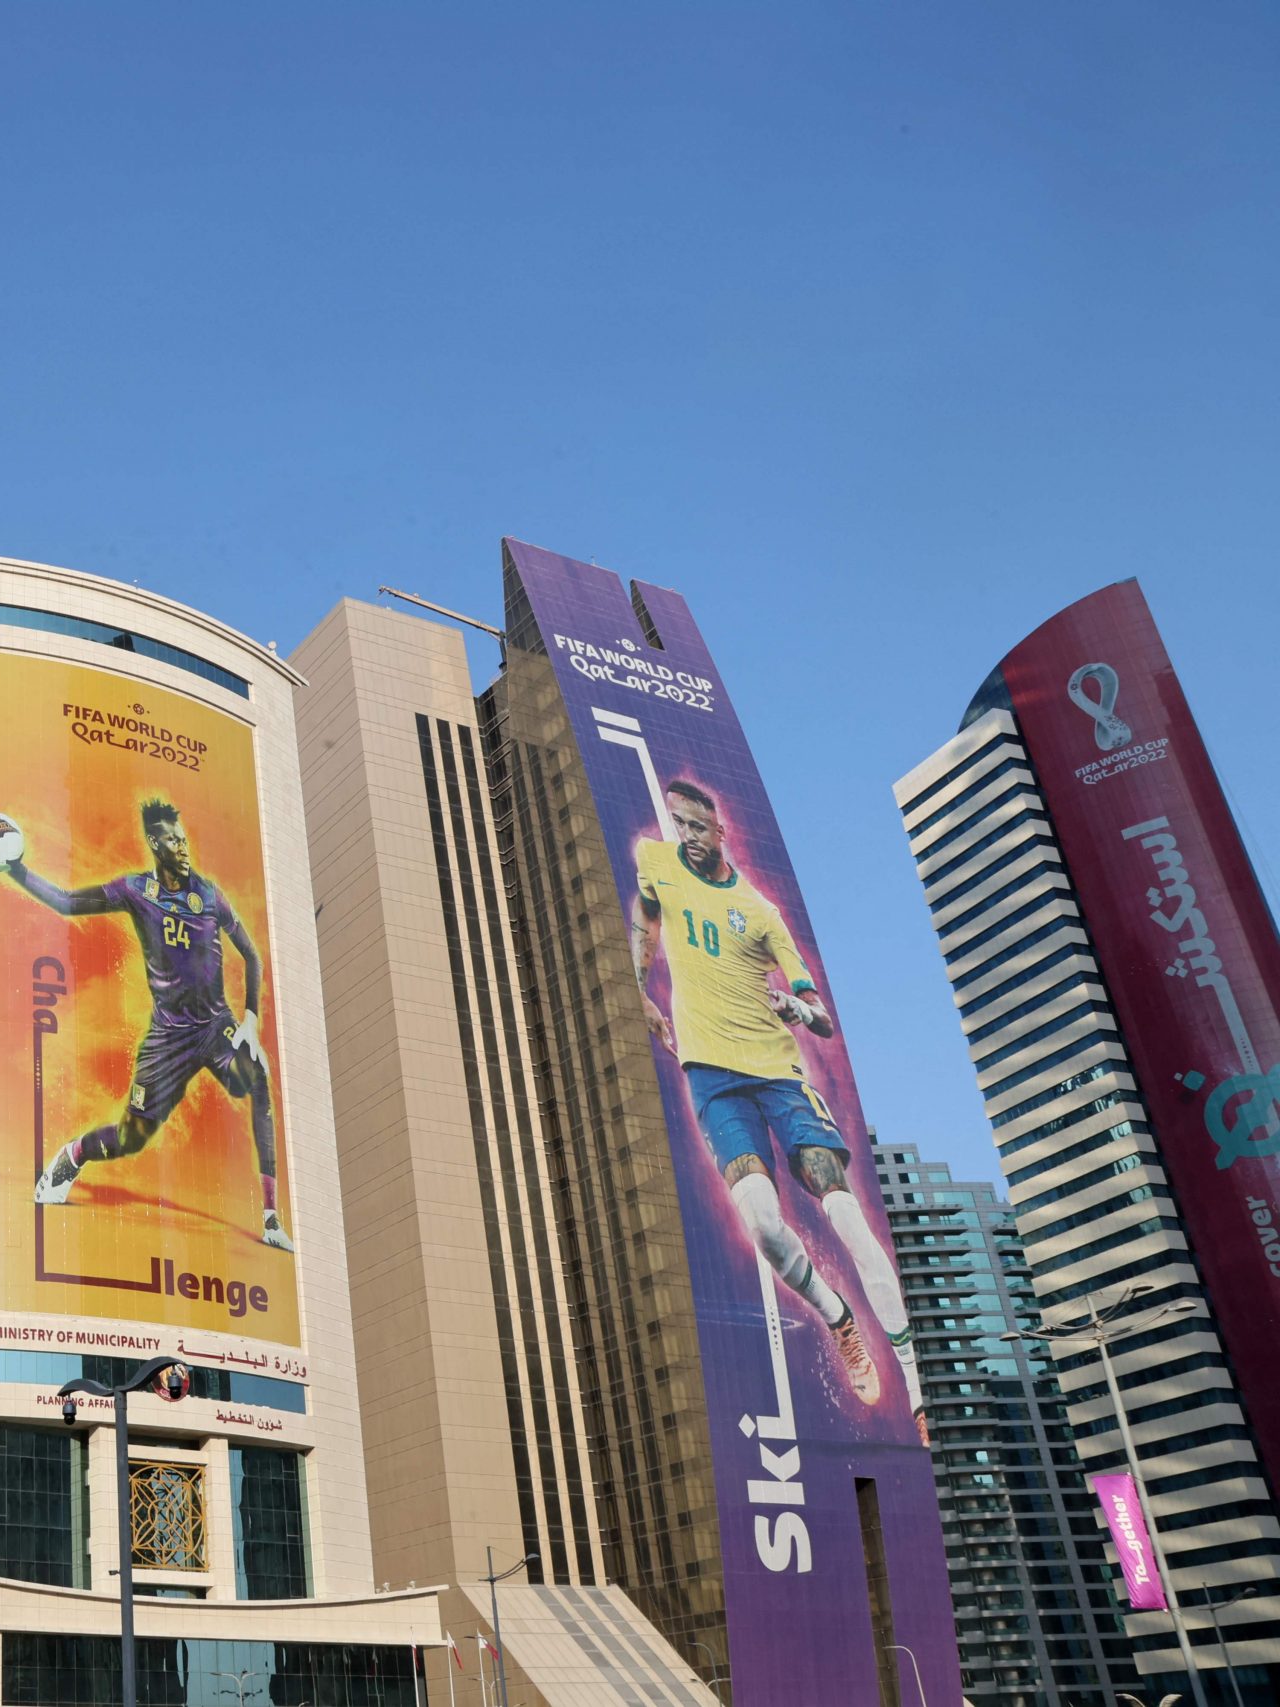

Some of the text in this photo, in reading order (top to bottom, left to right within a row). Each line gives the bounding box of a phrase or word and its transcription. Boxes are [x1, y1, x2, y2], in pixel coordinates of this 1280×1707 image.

[552, 633, 713, 694] FIFA WORLD CUP
[62, 703, 208, 756] FIFA WORLD CUP
[1074, 737, 1170, 779] FIFA WORLD CUP
[163, 916, 191, 950] 24
[682, 908, 720, 957] 10
[56, 1330, 73, 1343] OF
[75, 1332, 161, 1351] MUNICIPALITY
[274, 1356, 308, 1378] وزارة
[36, 1395, 84, 1407] PLANNNG
